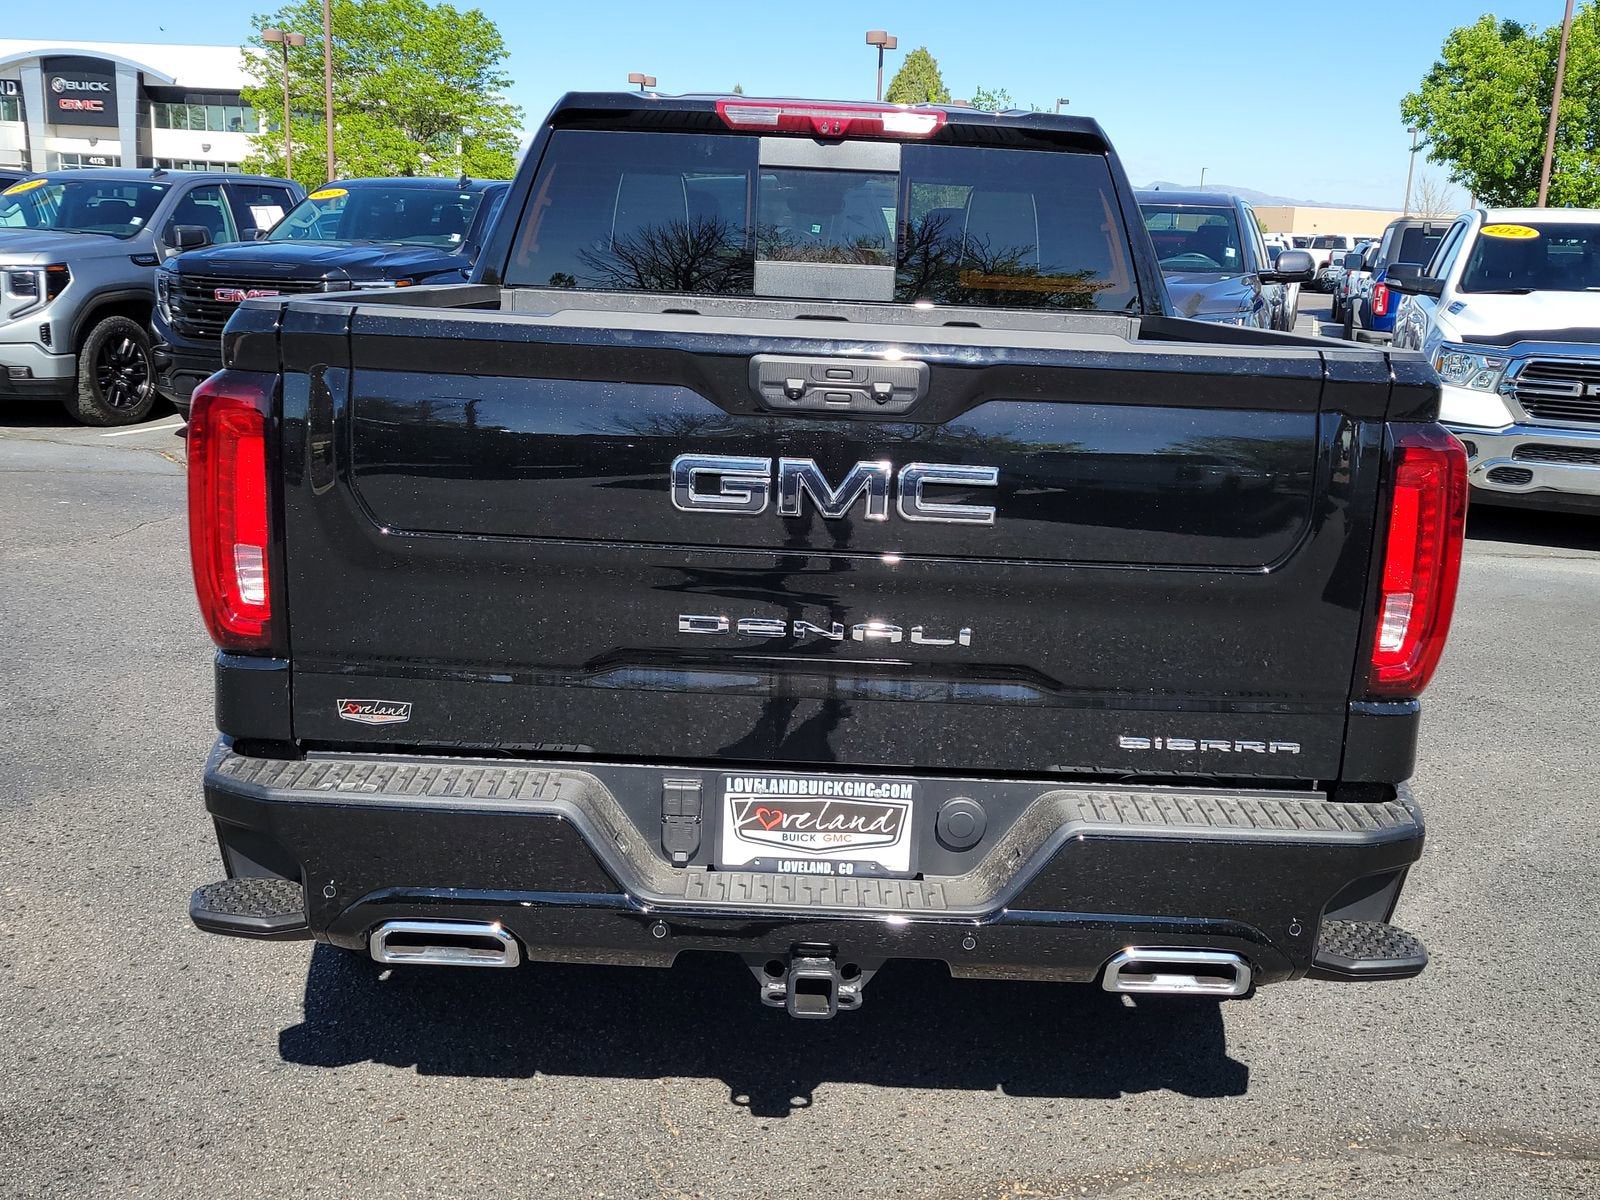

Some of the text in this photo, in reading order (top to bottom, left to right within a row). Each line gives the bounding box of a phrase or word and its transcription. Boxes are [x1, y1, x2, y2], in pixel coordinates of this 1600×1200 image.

[65, 81, 110, 91] BUICK
[59, 98, 104, 111] GMC
[89, 157, 106, 165] 4175
[1487, 226, 1533, 236] 2021
[214, 288, 280, 302] GMC
[671, 454, 999, 525] GMC
[679, 614, 972, 646] DENALI
[339, 699, 408, 716] Loveland
[1119, 736, 1301, 754] SIERRA
[726, 777, 913, 799] LOVELANDBUICKGMCCOM
[734, 797, 896, 833] Loveland
[782, 833, 852, 843] BUICK GMC
[778, 860, 854, 876] LOVELAND, CO
